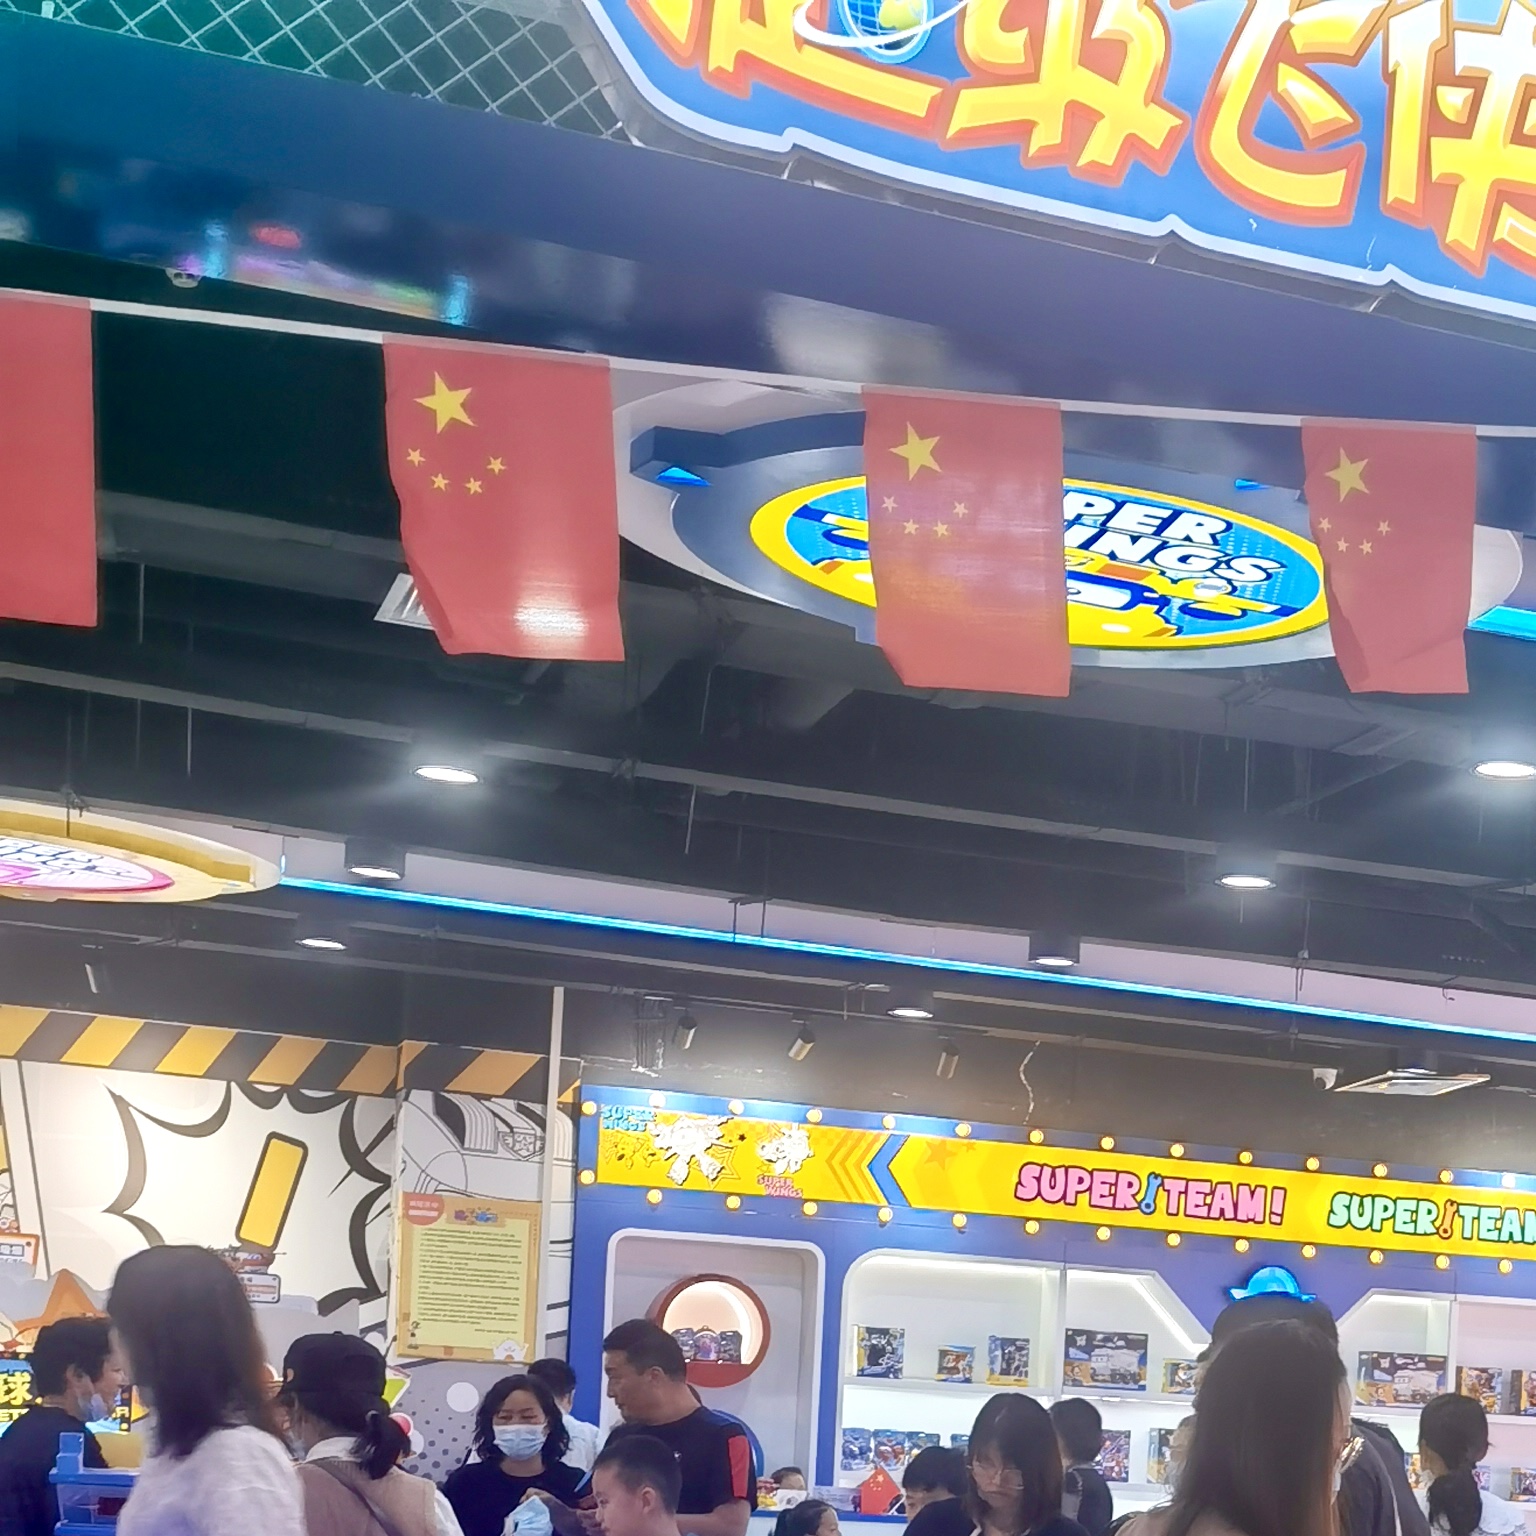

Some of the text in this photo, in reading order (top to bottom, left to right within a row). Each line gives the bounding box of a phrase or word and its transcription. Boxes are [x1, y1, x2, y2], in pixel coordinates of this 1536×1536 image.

[1063, 490, 1227, 547] PER
[1064, 523, 1288, 583] INGS
[1014, 1161, 1287, 1225] SUPER TEAM!
[1328, 1191, 1440, 1236] SUPER
